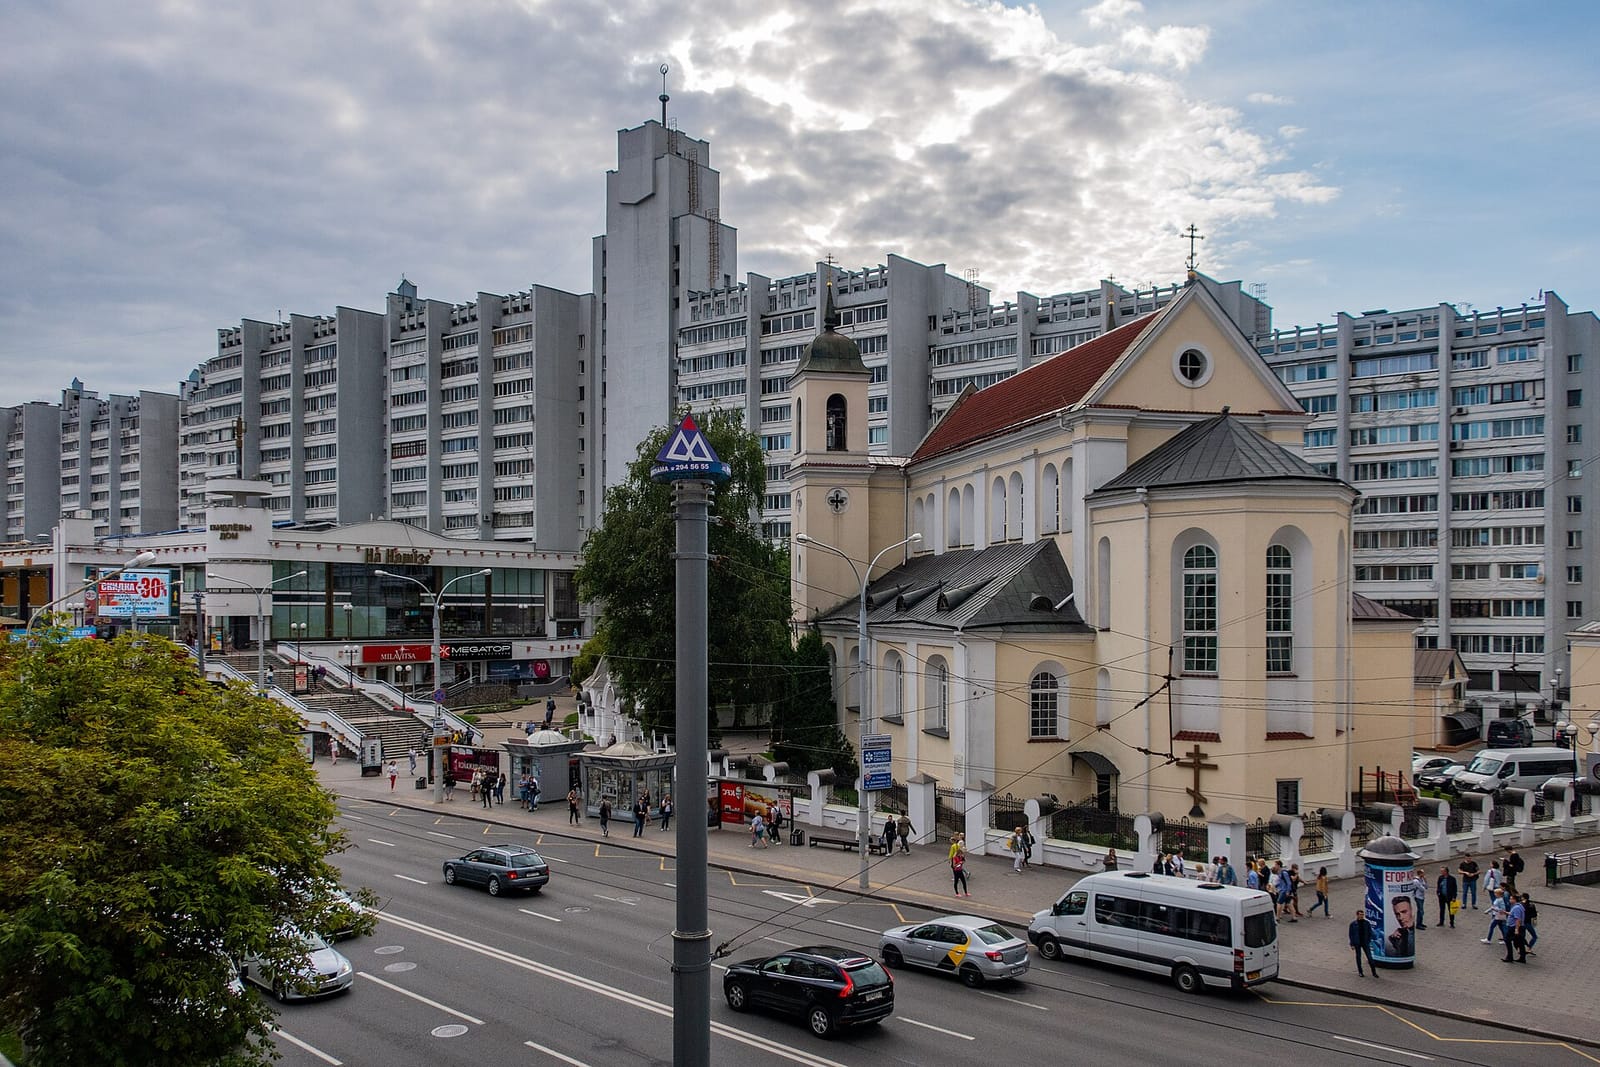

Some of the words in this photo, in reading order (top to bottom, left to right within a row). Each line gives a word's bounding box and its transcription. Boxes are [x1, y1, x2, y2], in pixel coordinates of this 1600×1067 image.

[219, 532, 239, 541] ДОМ
[101, 582, 135, 592] СКИДКА
[451, 645, 511, 654] MEGATOP
[1385, 871, 1406, 883] ЕГОР
